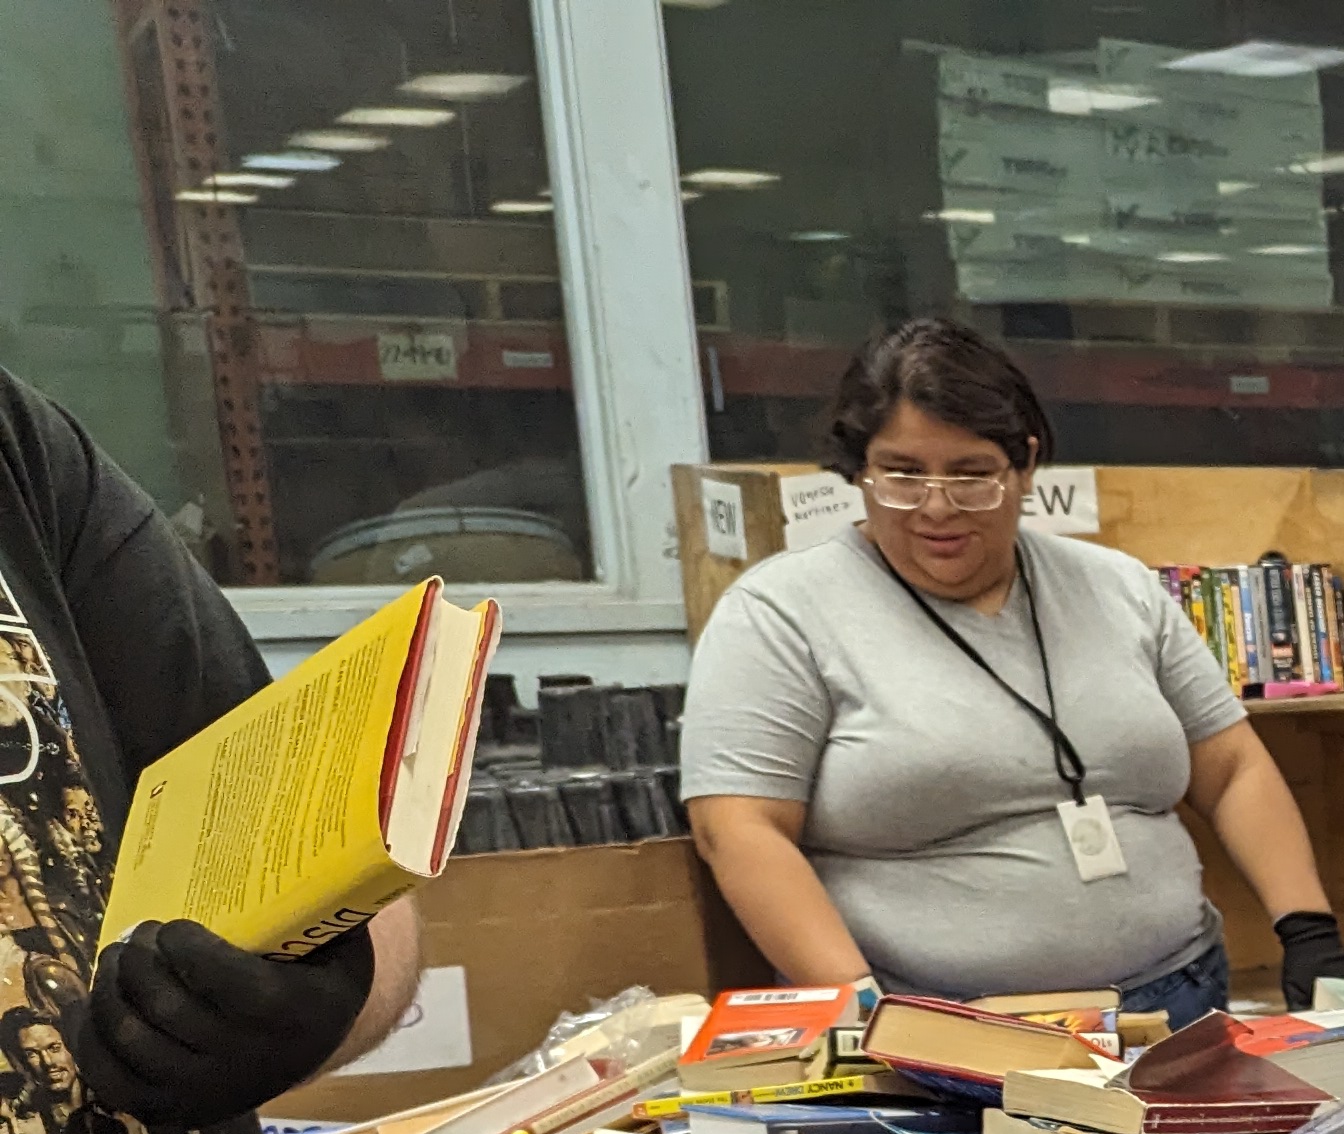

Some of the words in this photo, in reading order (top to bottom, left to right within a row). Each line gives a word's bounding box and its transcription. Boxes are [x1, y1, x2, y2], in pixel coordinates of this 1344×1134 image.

[1020, 484, 1075, 516] EW
[774, 1086, 804, 1097] DREW
[807, 1081, 844, 1093] NANCY
